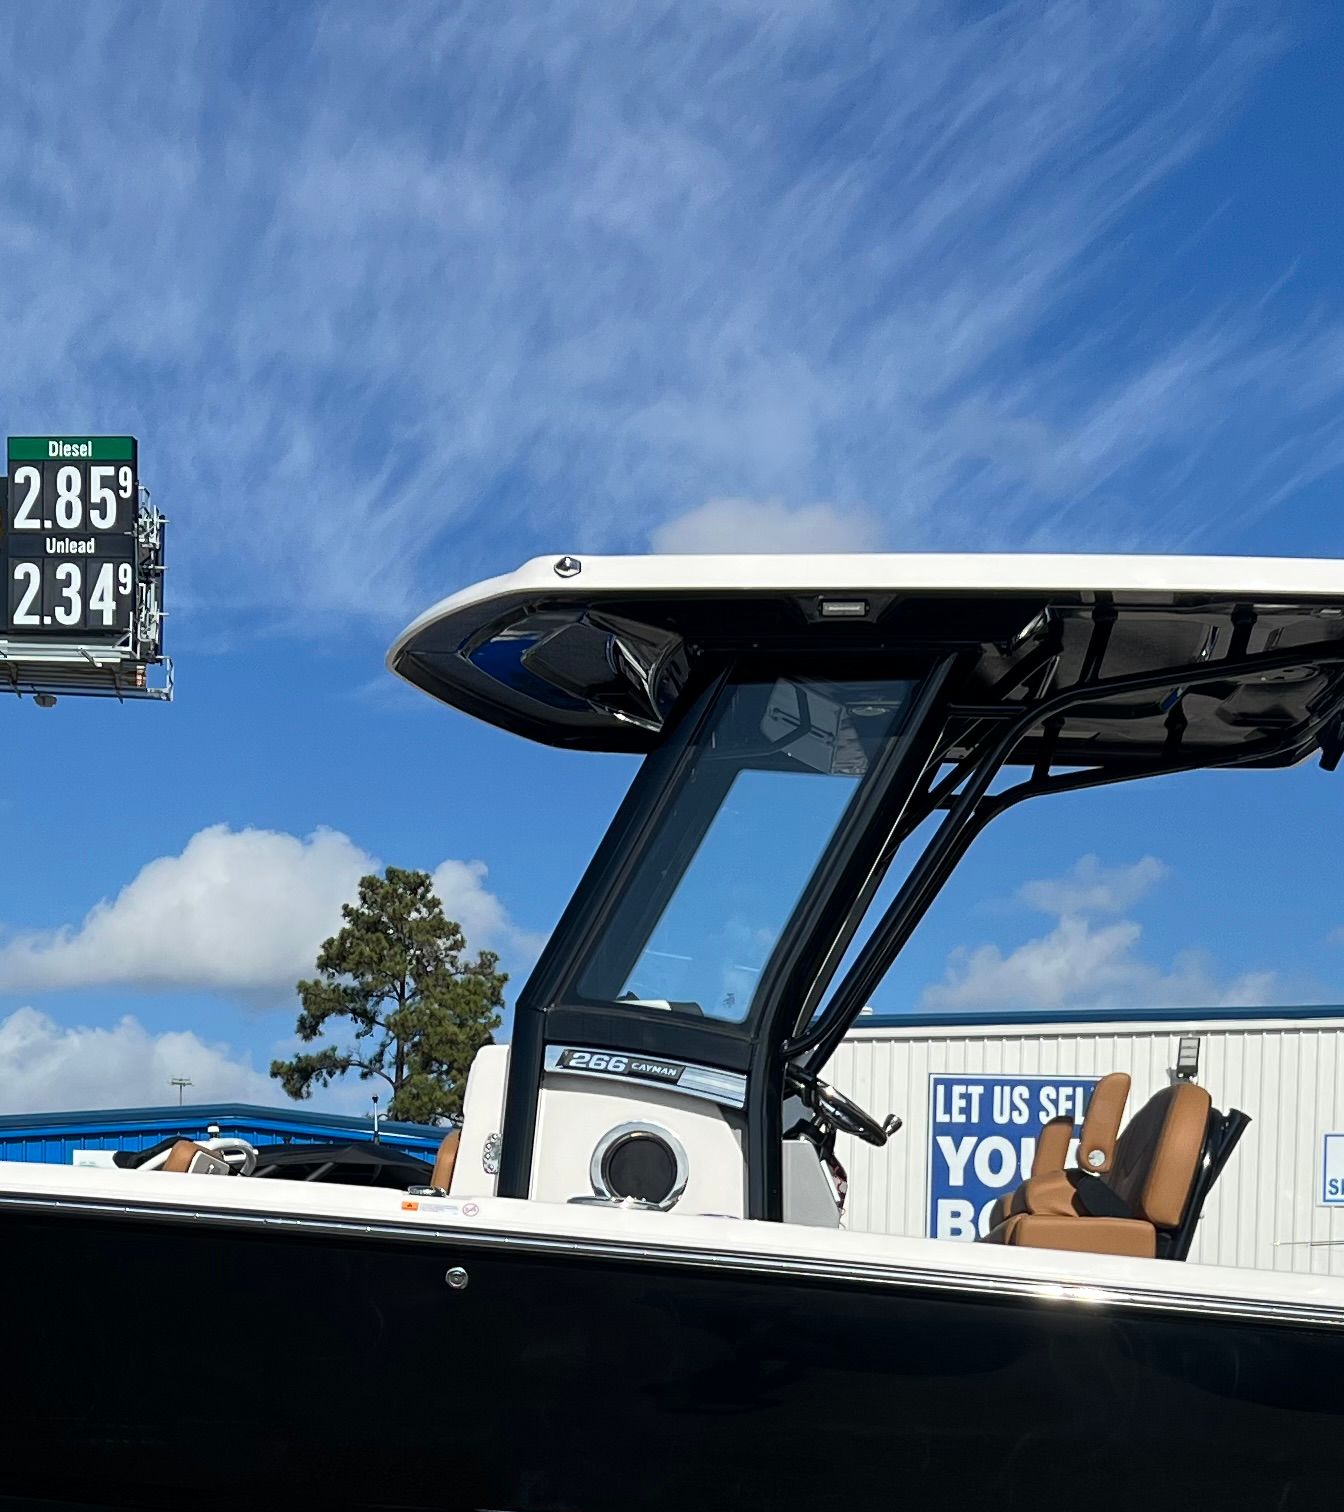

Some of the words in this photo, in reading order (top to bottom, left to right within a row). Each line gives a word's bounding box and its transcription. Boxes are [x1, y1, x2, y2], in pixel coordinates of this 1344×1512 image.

[48, 441, 92, 457] Diesel
[46, 537, 95, 554] Unlead
[568, 1051, 630, 1073] 266
[630, 1062, 678, 1077] CAYMAN
[936, 1084, 985, 1123] LET
[993, 1085, 1030, 1124] US
[1039, 1085, 1094, 1125] SEL
